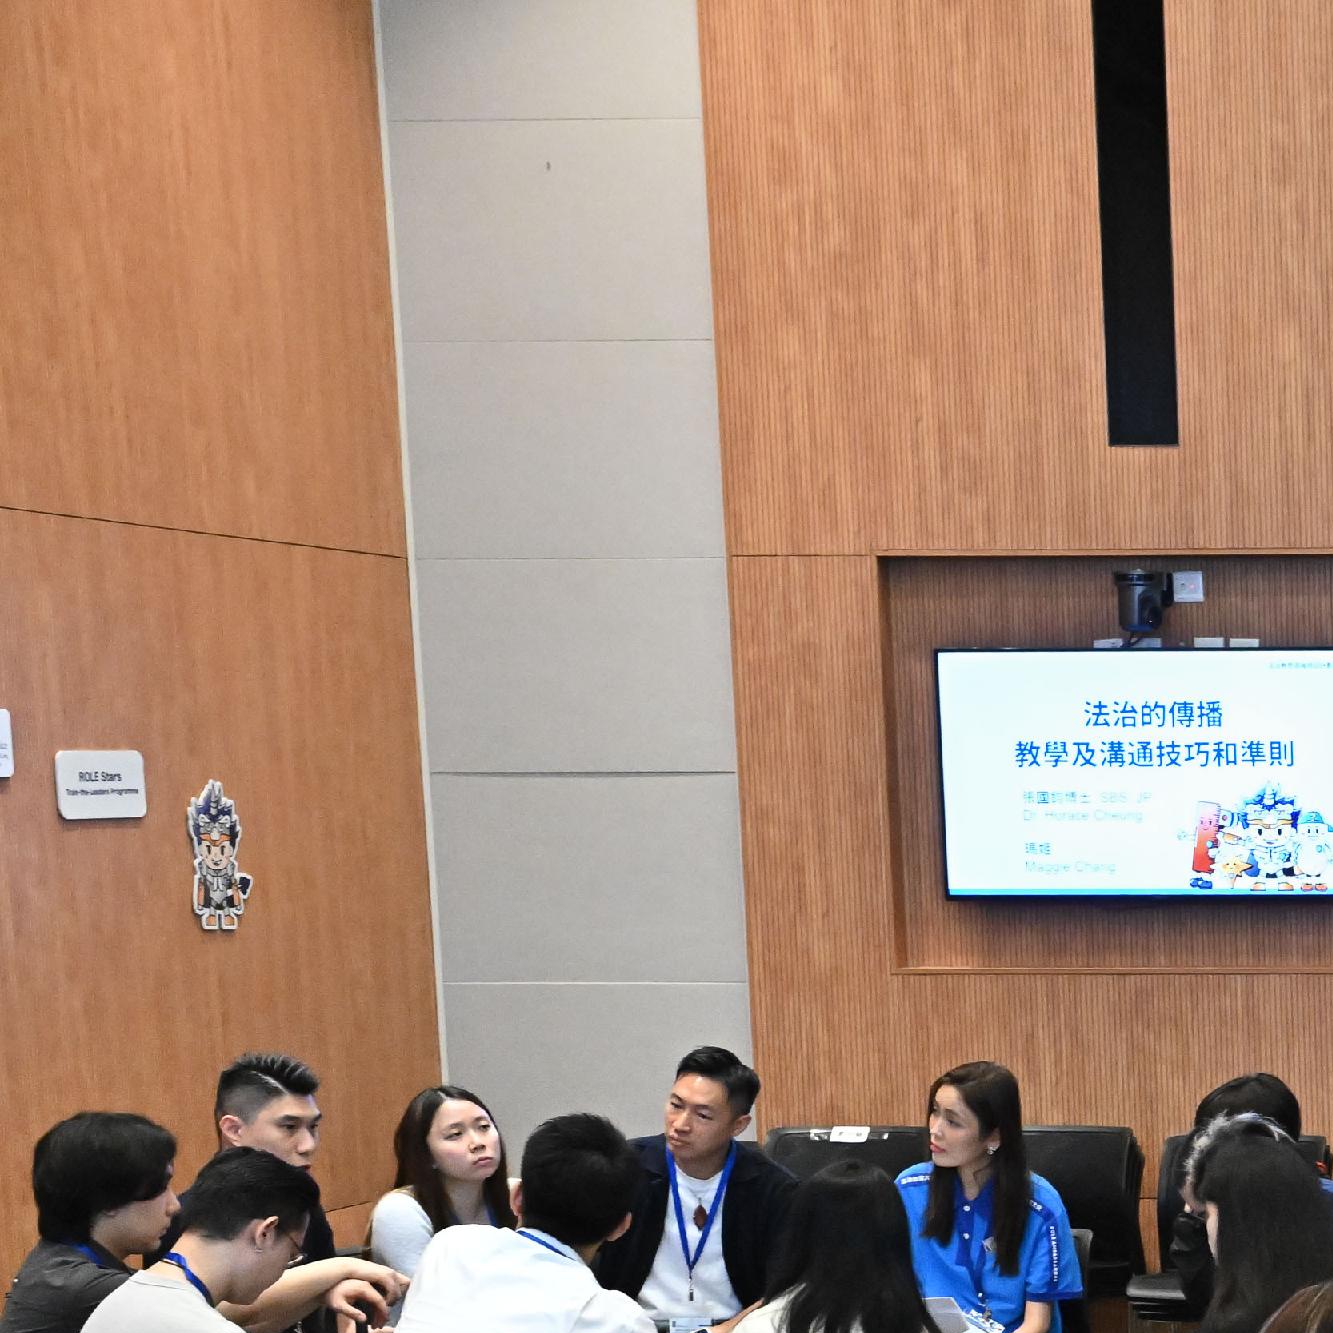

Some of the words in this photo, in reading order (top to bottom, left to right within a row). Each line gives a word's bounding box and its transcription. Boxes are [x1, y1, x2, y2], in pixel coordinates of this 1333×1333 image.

[1084, 700, 1223, 729] 法治的傳播
[1014, 740, 1295, 769] 教學及溝通技巧和準則
[78, 771, 99, 782] ROLE
[101, 771, 123, 782] Stars
